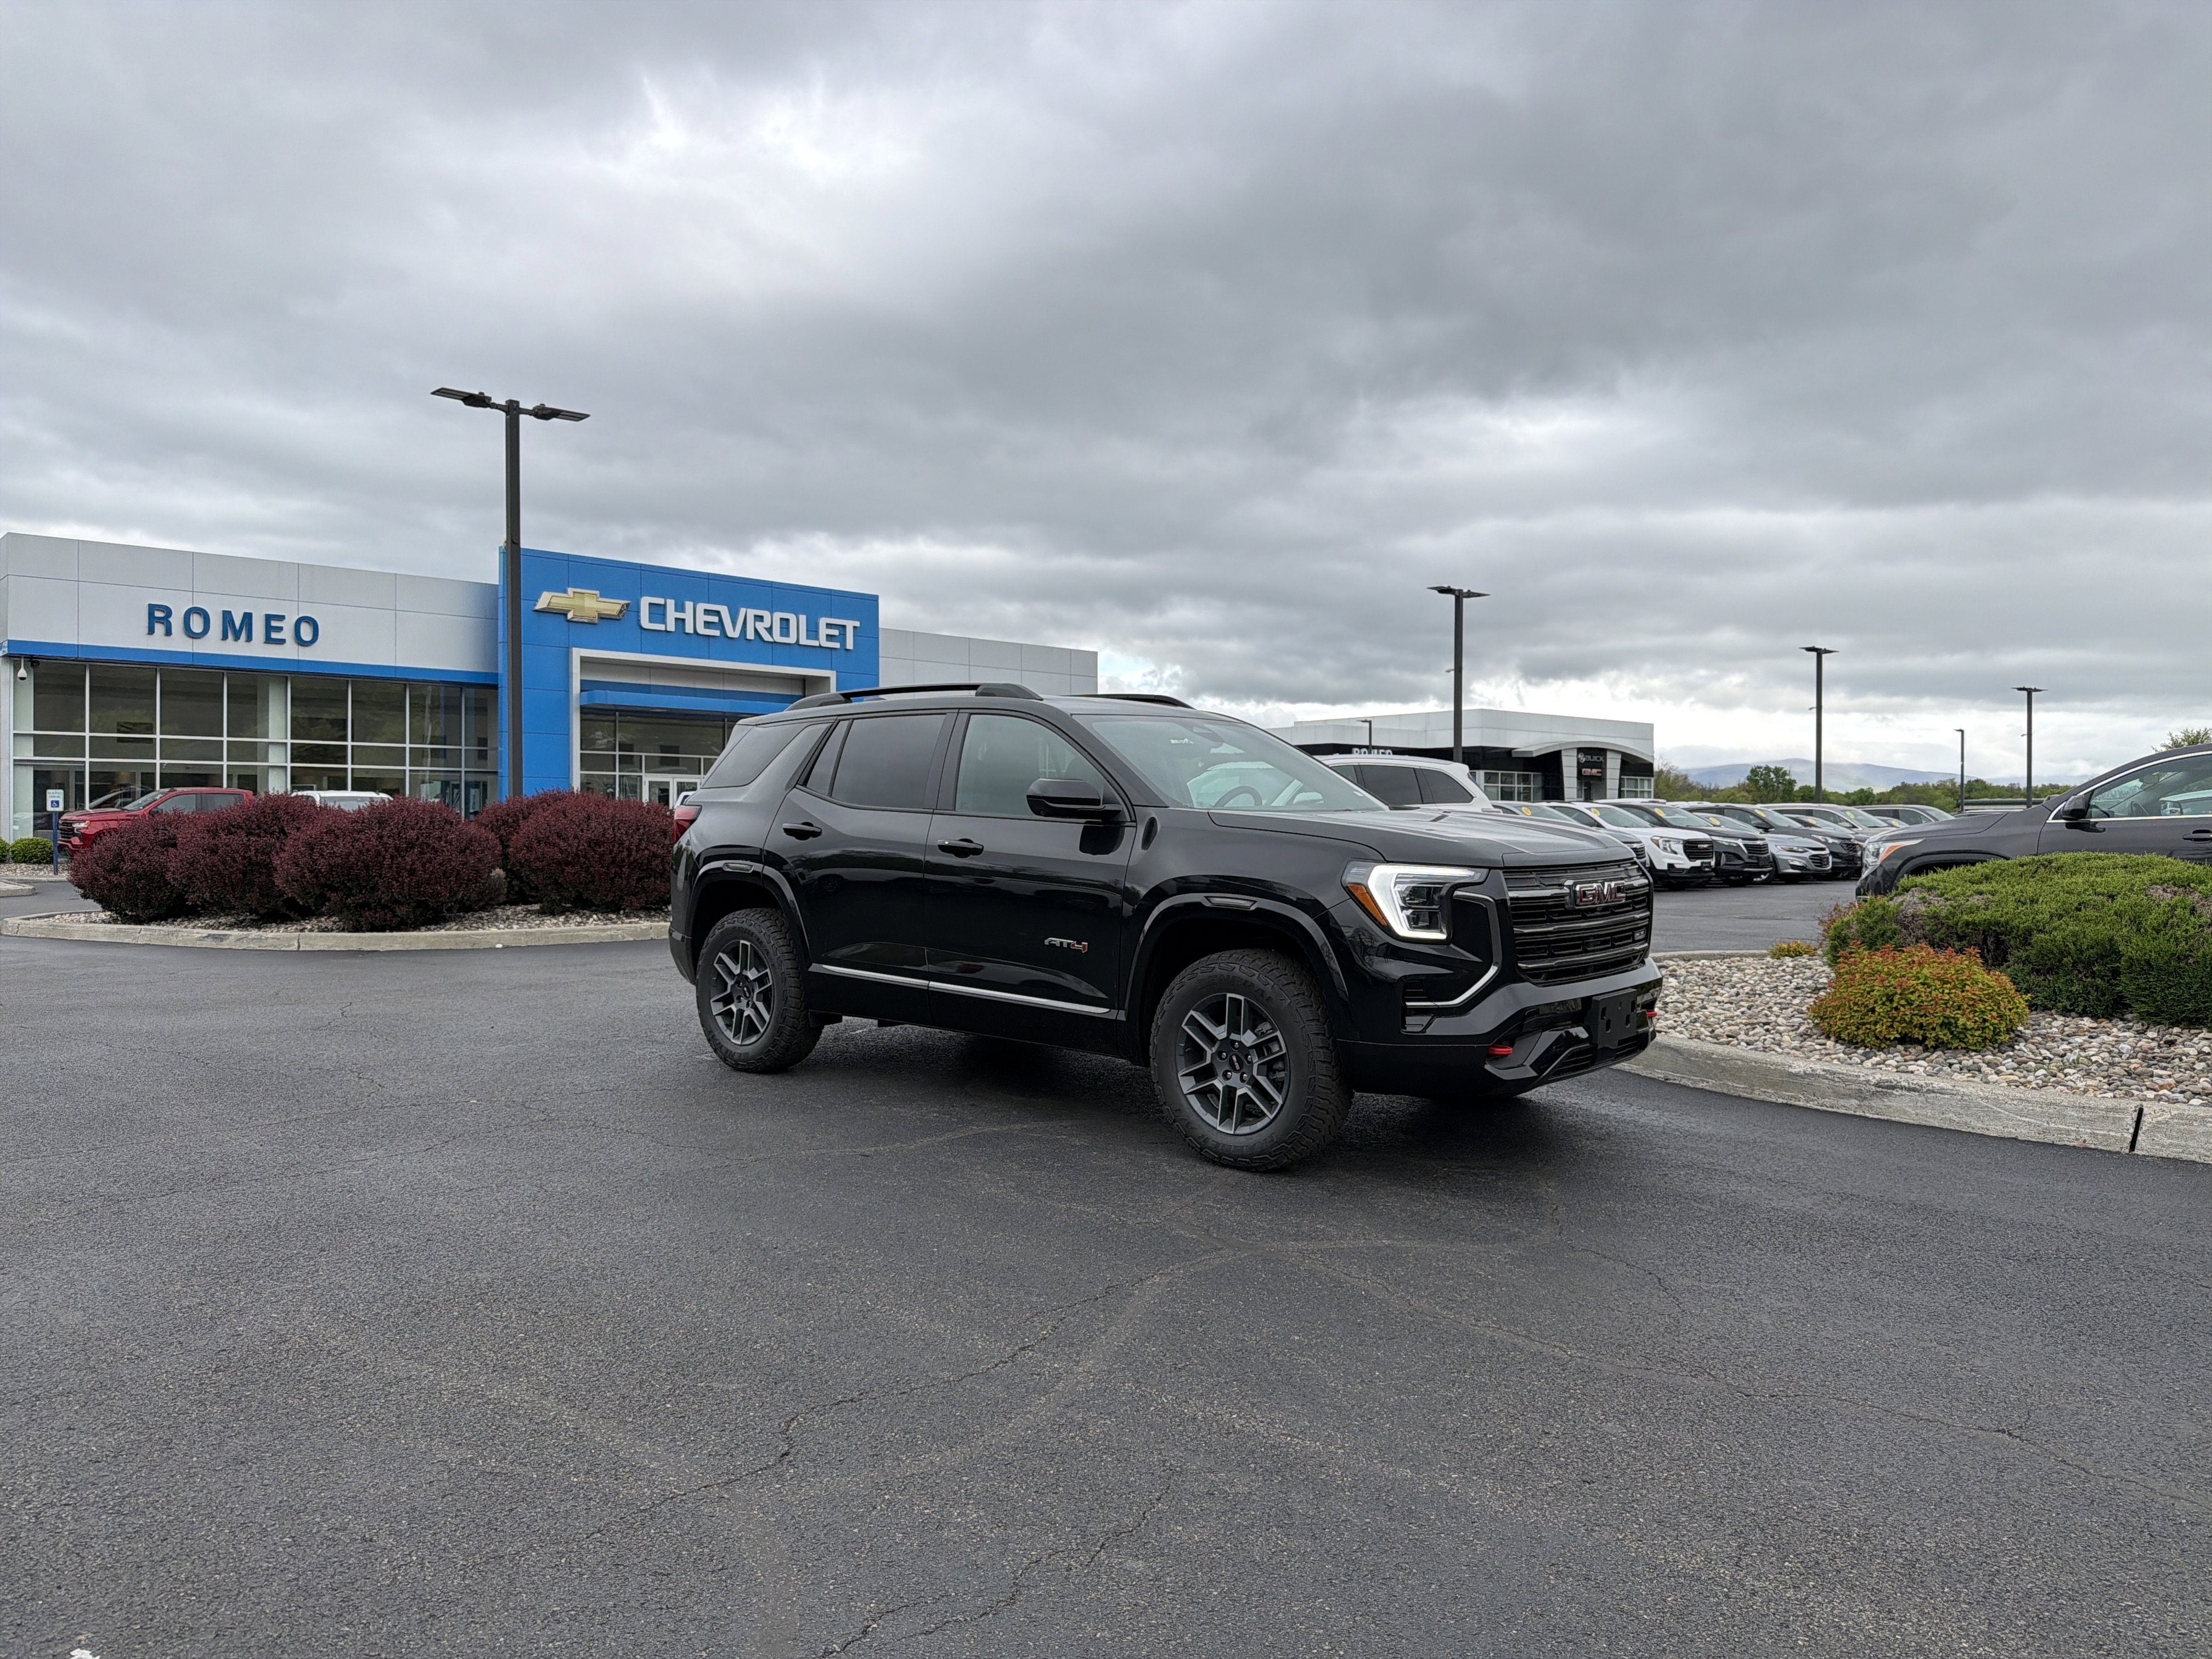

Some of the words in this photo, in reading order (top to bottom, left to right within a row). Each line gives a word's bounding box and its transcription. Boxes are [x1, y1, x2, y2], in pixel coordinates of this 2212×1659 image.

[146, 603, 319, 647] ROMEO
[640, 596, 860, 650] CHEVROLET
[1582, 768, 1602, 776] GMC
[1576, 880, 1626, 905] GMC
[1044, 937, 1088, 953] AT4
